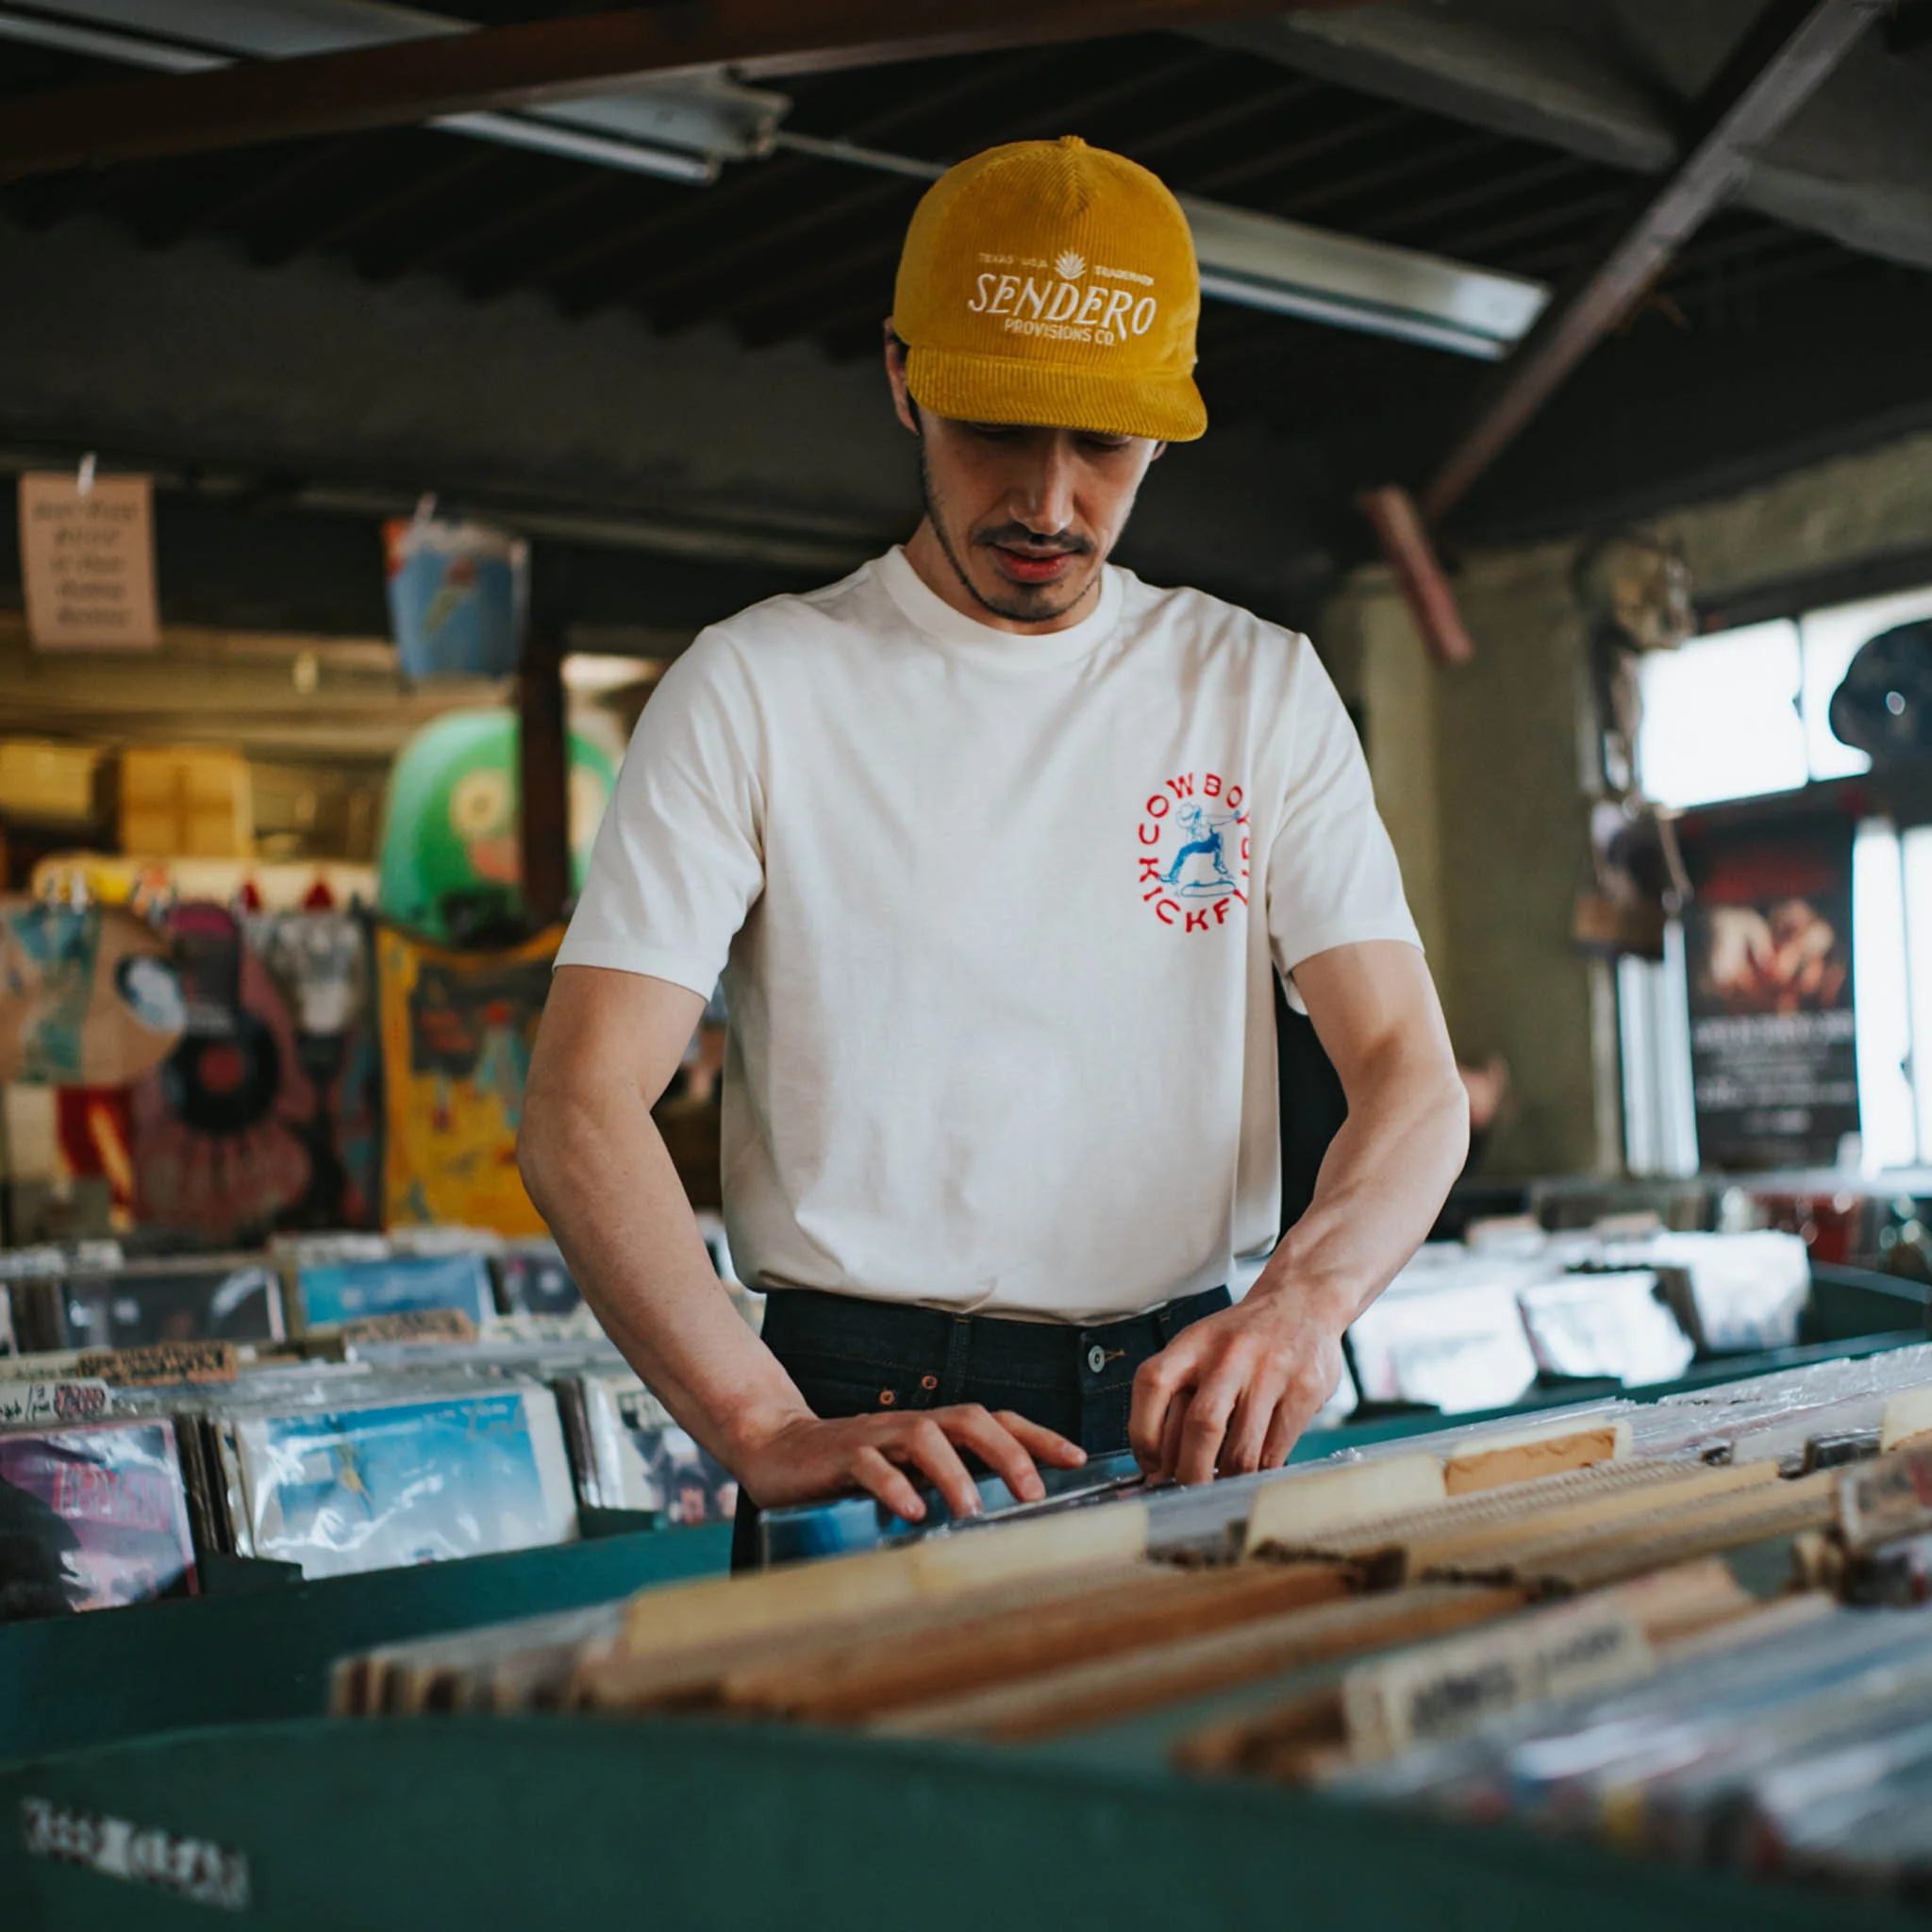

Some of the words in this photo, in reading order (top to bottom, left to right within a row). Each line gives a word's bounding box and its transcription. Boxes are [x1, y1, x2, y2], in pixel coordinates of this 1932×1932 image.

[968, 273, 1158, 341] SENDERO
[1005, 318, 1092, 342] PROVISIONS
[1138, 773, 1251, 845] COWBOY
